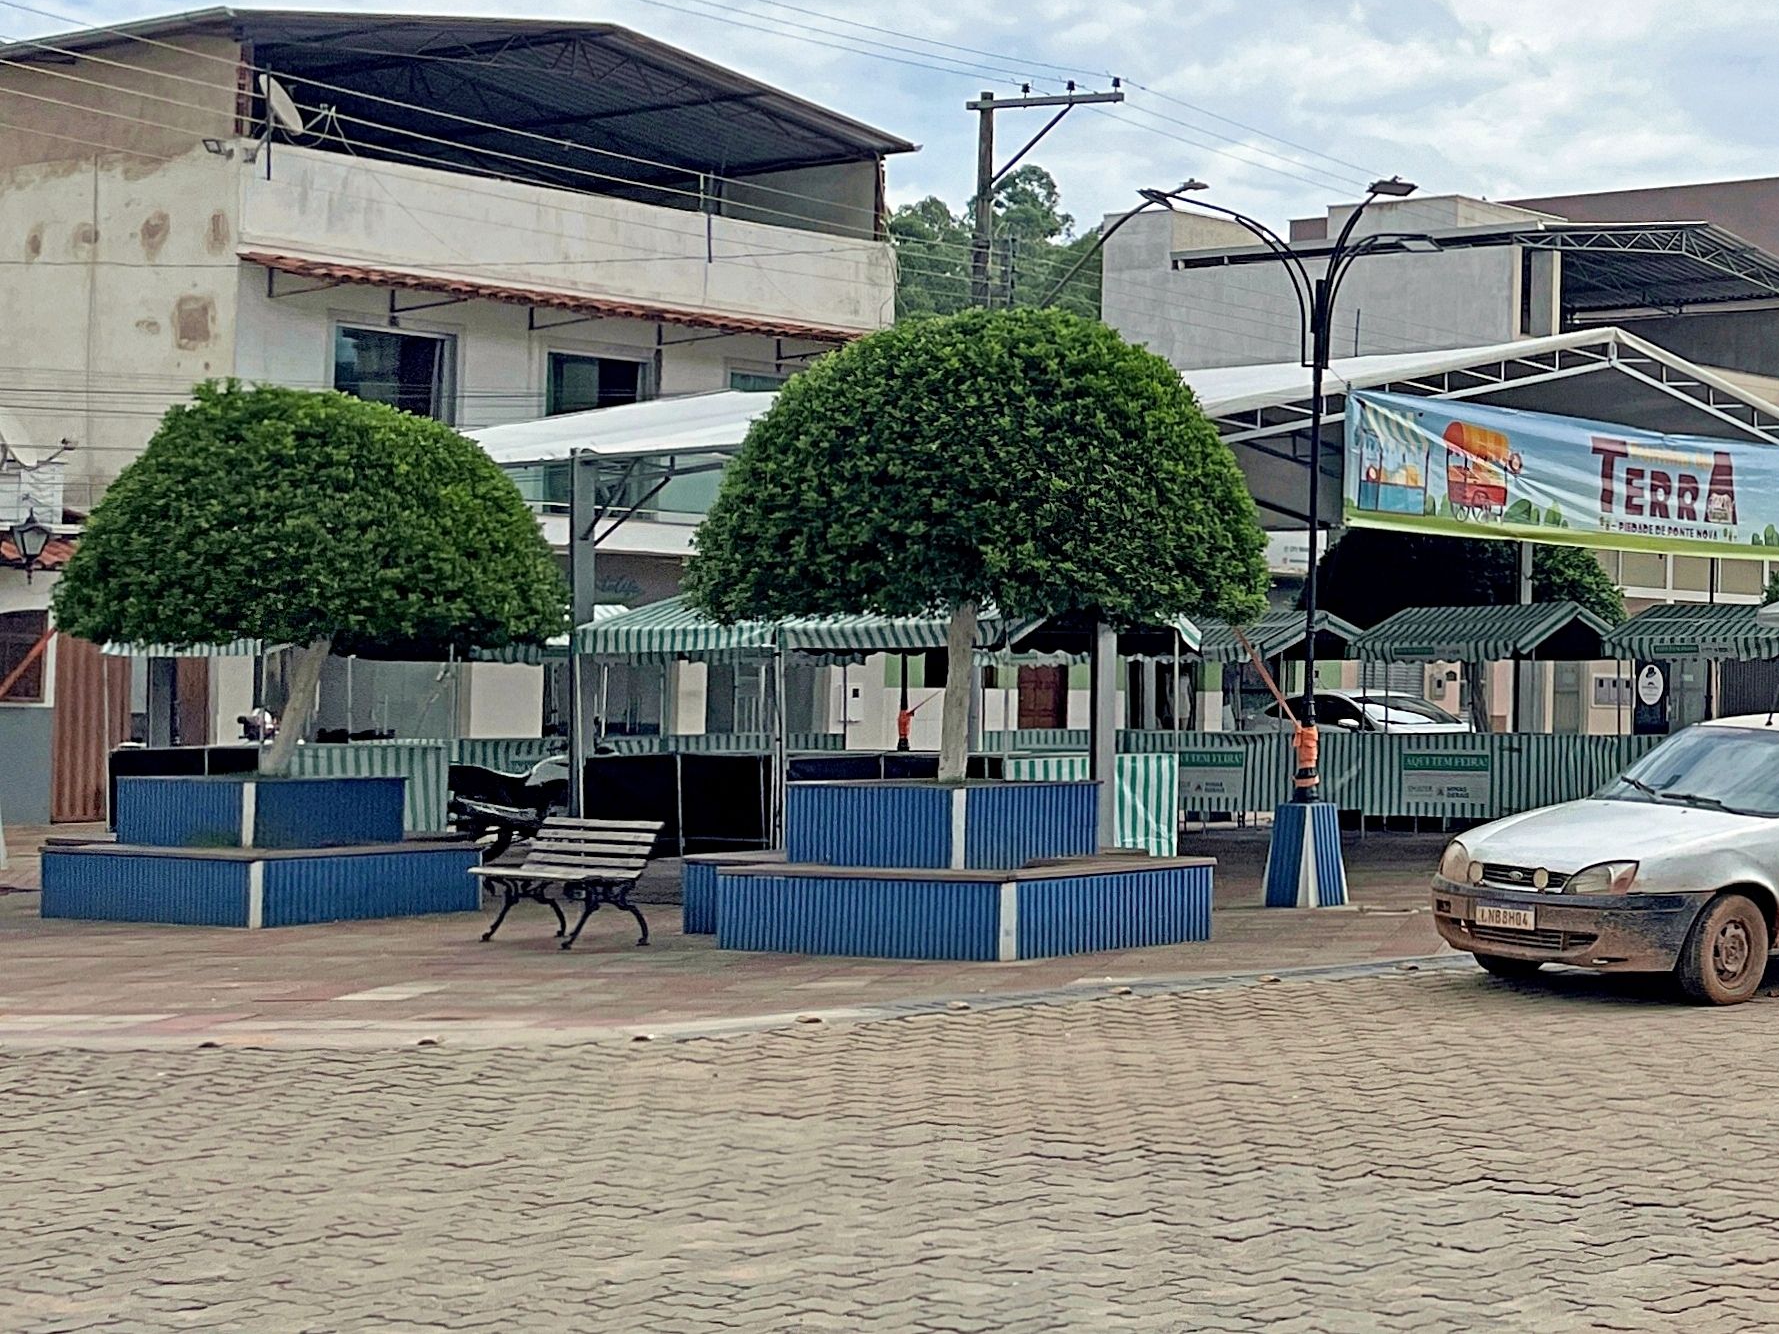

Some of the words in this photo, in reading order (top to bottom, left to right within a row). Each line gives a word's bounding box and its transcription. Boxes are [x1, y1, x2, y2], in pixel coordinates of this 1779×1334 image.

[1618, 521, 1653, 535] PIEDADE
[1655, 525, 1666, 536] DE
[1668, 525, 1694, 538] PONTE
[1696, 529, 1718, 540] NOVA
[1434, 756, 1453, 767] TEM
